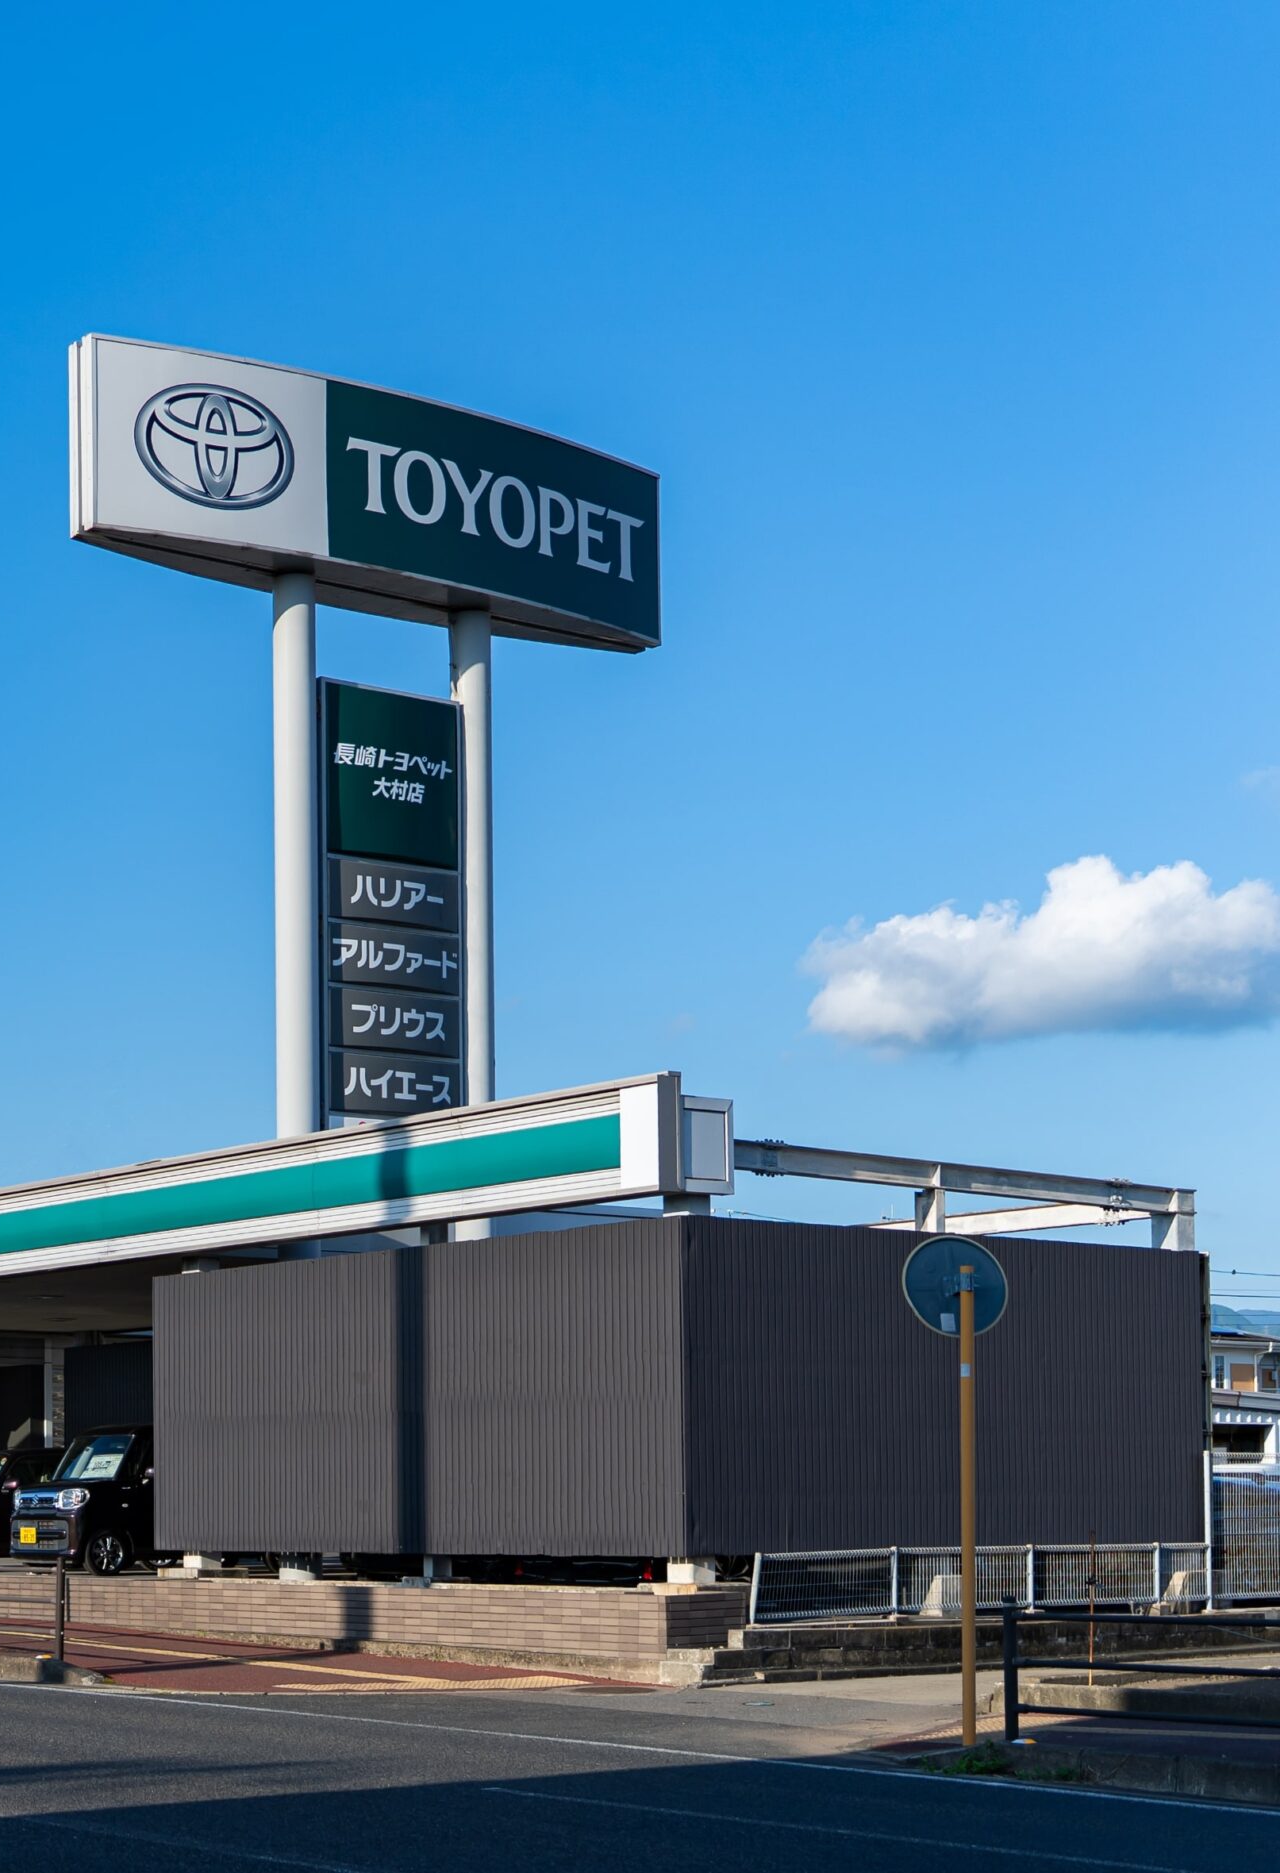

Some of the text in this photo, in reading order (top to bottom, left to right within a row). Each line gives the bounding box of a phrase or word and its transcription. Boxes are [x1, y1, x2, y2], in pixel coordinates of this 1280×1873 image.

[346, 437, 645, 582] TOYOPET
[333, 742, 453, 781] 長崎トヨペット
[372, 776, 425, 804] 大村店
[350, 874, 444, 911] ハリアー
[332, 937, 459, 979] アルファード
[351, 1003, 446, 1041] プリウス
[344, 1066, 452, 1105] ハイエース
